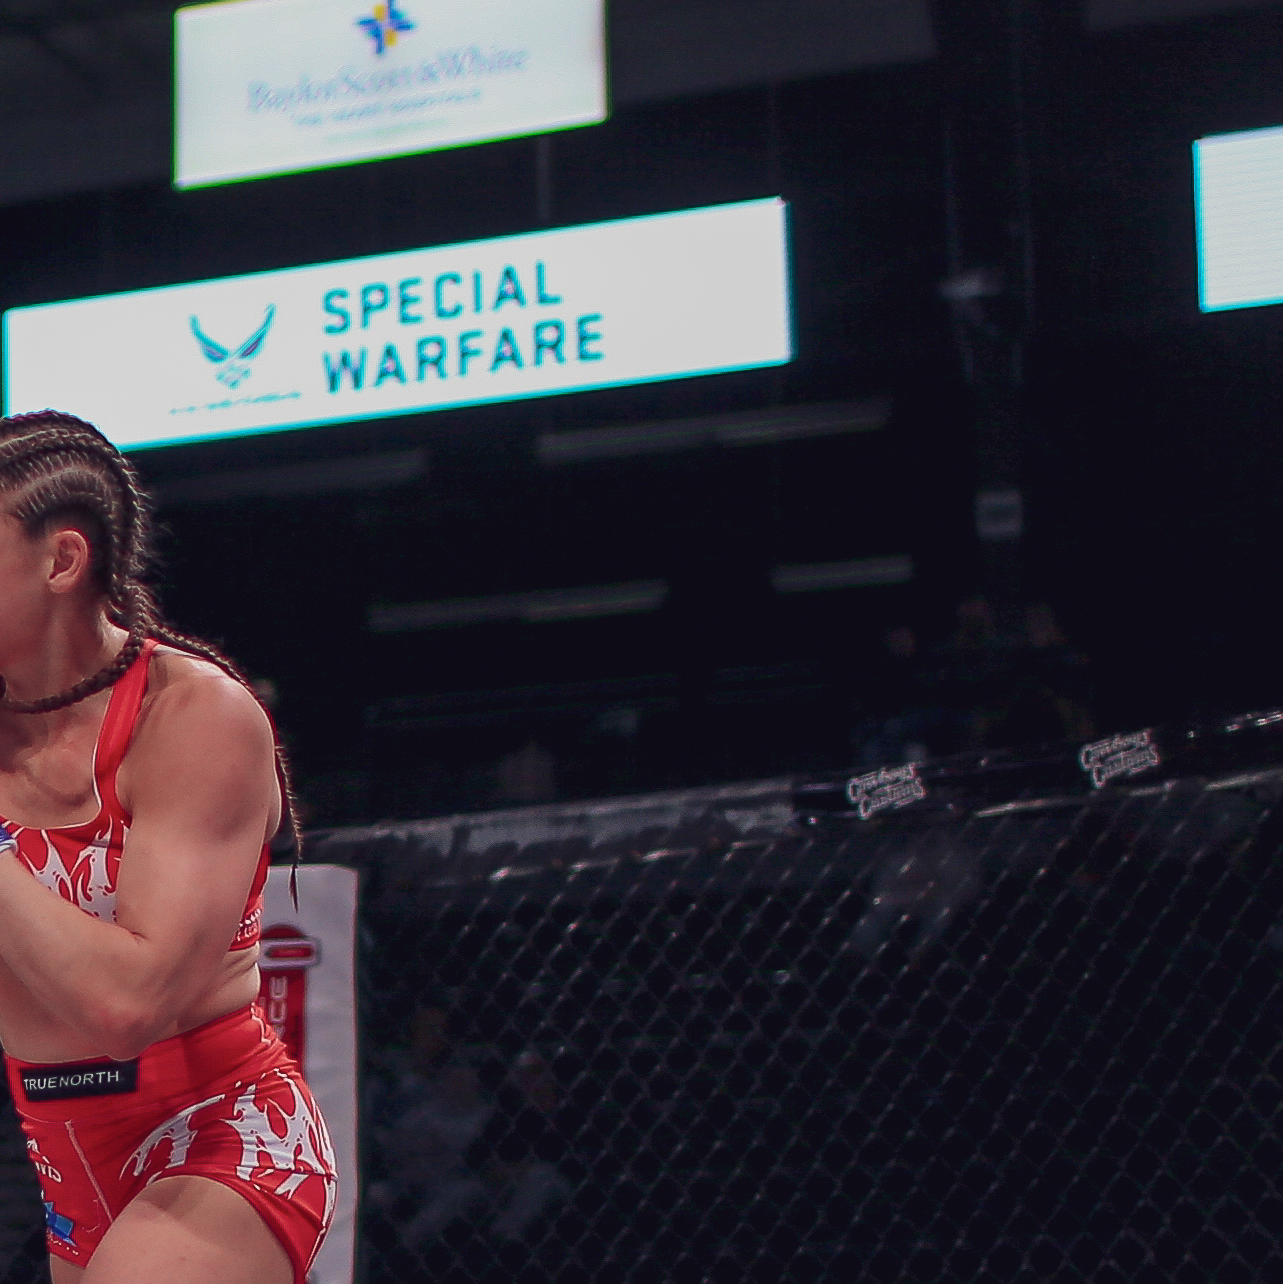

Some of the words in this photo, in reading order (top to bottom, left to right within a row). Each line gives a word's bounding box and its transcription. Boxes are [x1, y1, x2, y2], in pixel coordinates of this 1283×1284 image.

[322, 259, 562, 335] SPECIAL
[323, 312, 607, 394] WARFARE
[23, 1070, 119, 1091] TRUENORTH
